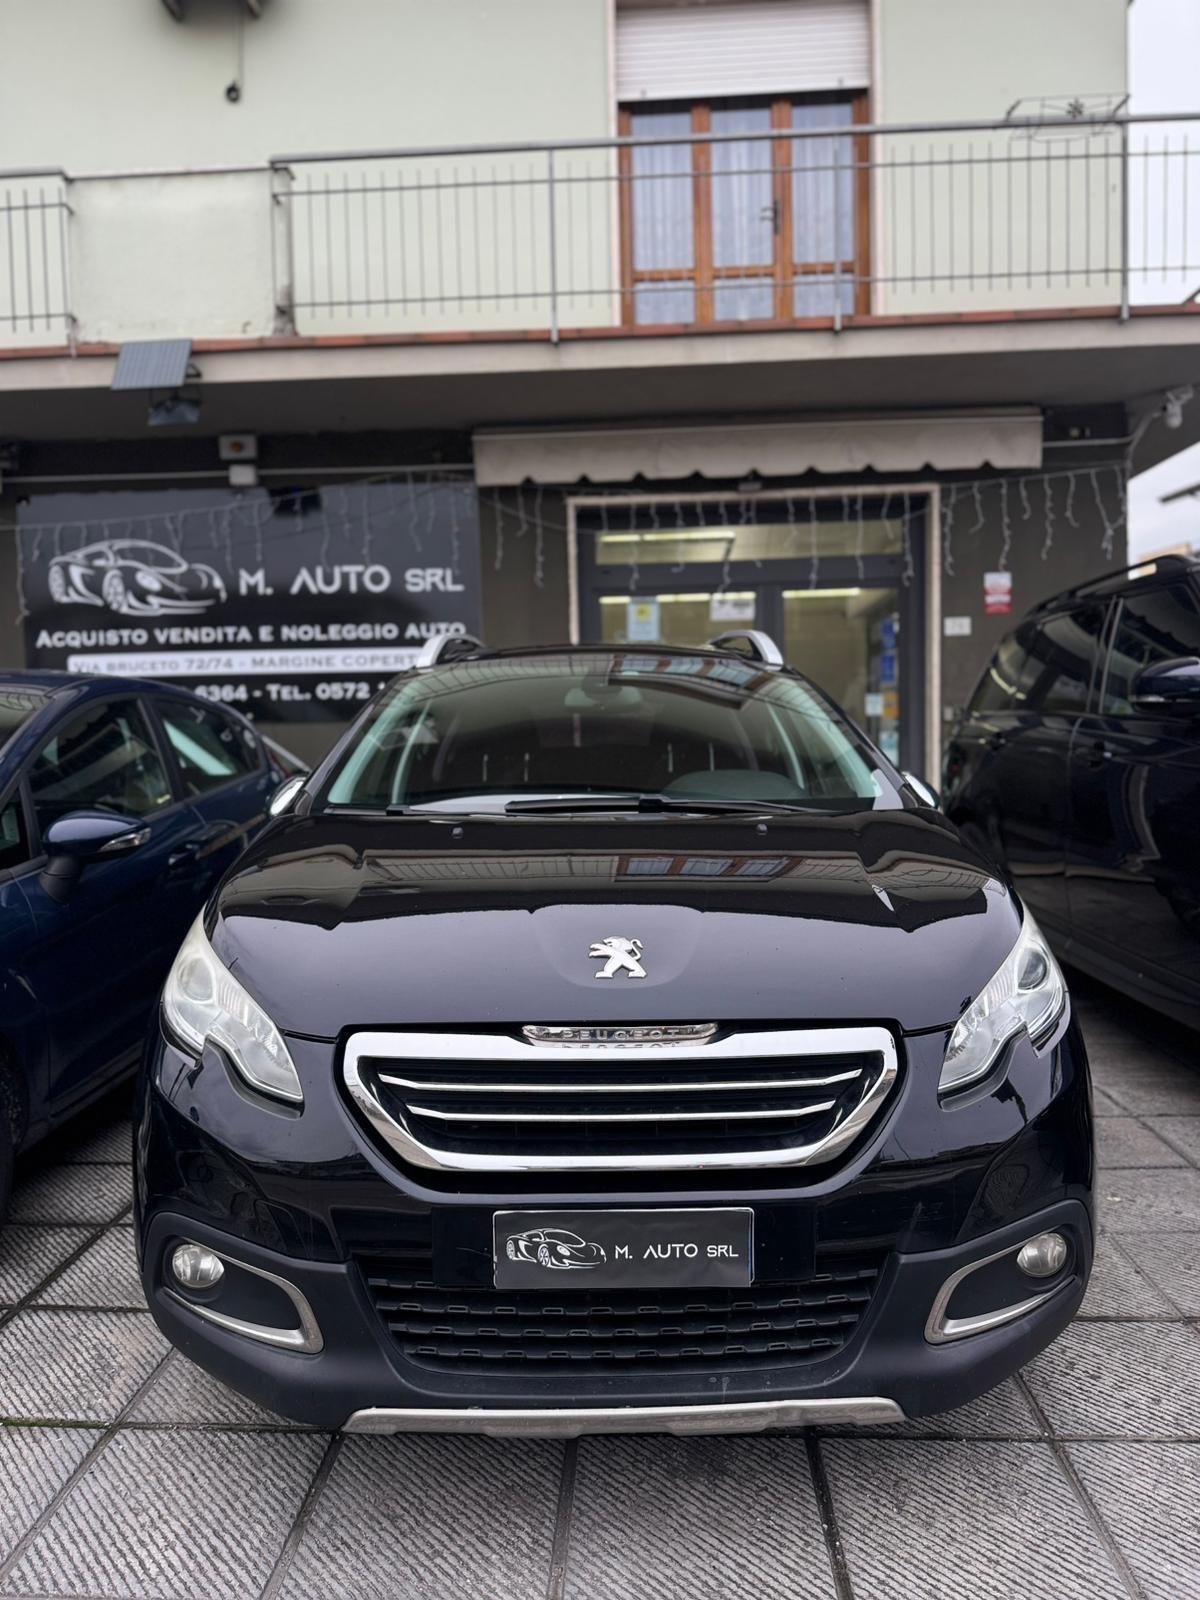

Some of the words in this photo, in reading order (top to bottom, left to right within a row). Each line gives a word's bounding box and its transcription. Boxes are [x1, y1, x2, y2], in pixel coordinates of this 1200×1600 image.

[239, 568, 274, 596] M.
[290, 564, 392, 594] AUTO
[404, 567, 465, 592] SRL
[36, 629, 149, 648] ACQUISTO
[153, 626, 253, 645] VENDITA
[258, 625, 275, 642] E
[280, 623, 400, 642] NOLEGGIO
[404, 622, 467, 640] AUTO
[184, 657, 233, 671] 72/74
[251, 654, 337, 669] MARGINE
[341, 652, 419, 668] COPERT
[315, 681, 372, 701] 0572
[561, 1028, 680, 1041] PEUGEOT
[614, 1244, 634, 1260] M.
[642, 1243, 699, 1259] AUTO
[706, 1244, 740, 1258] SRL
